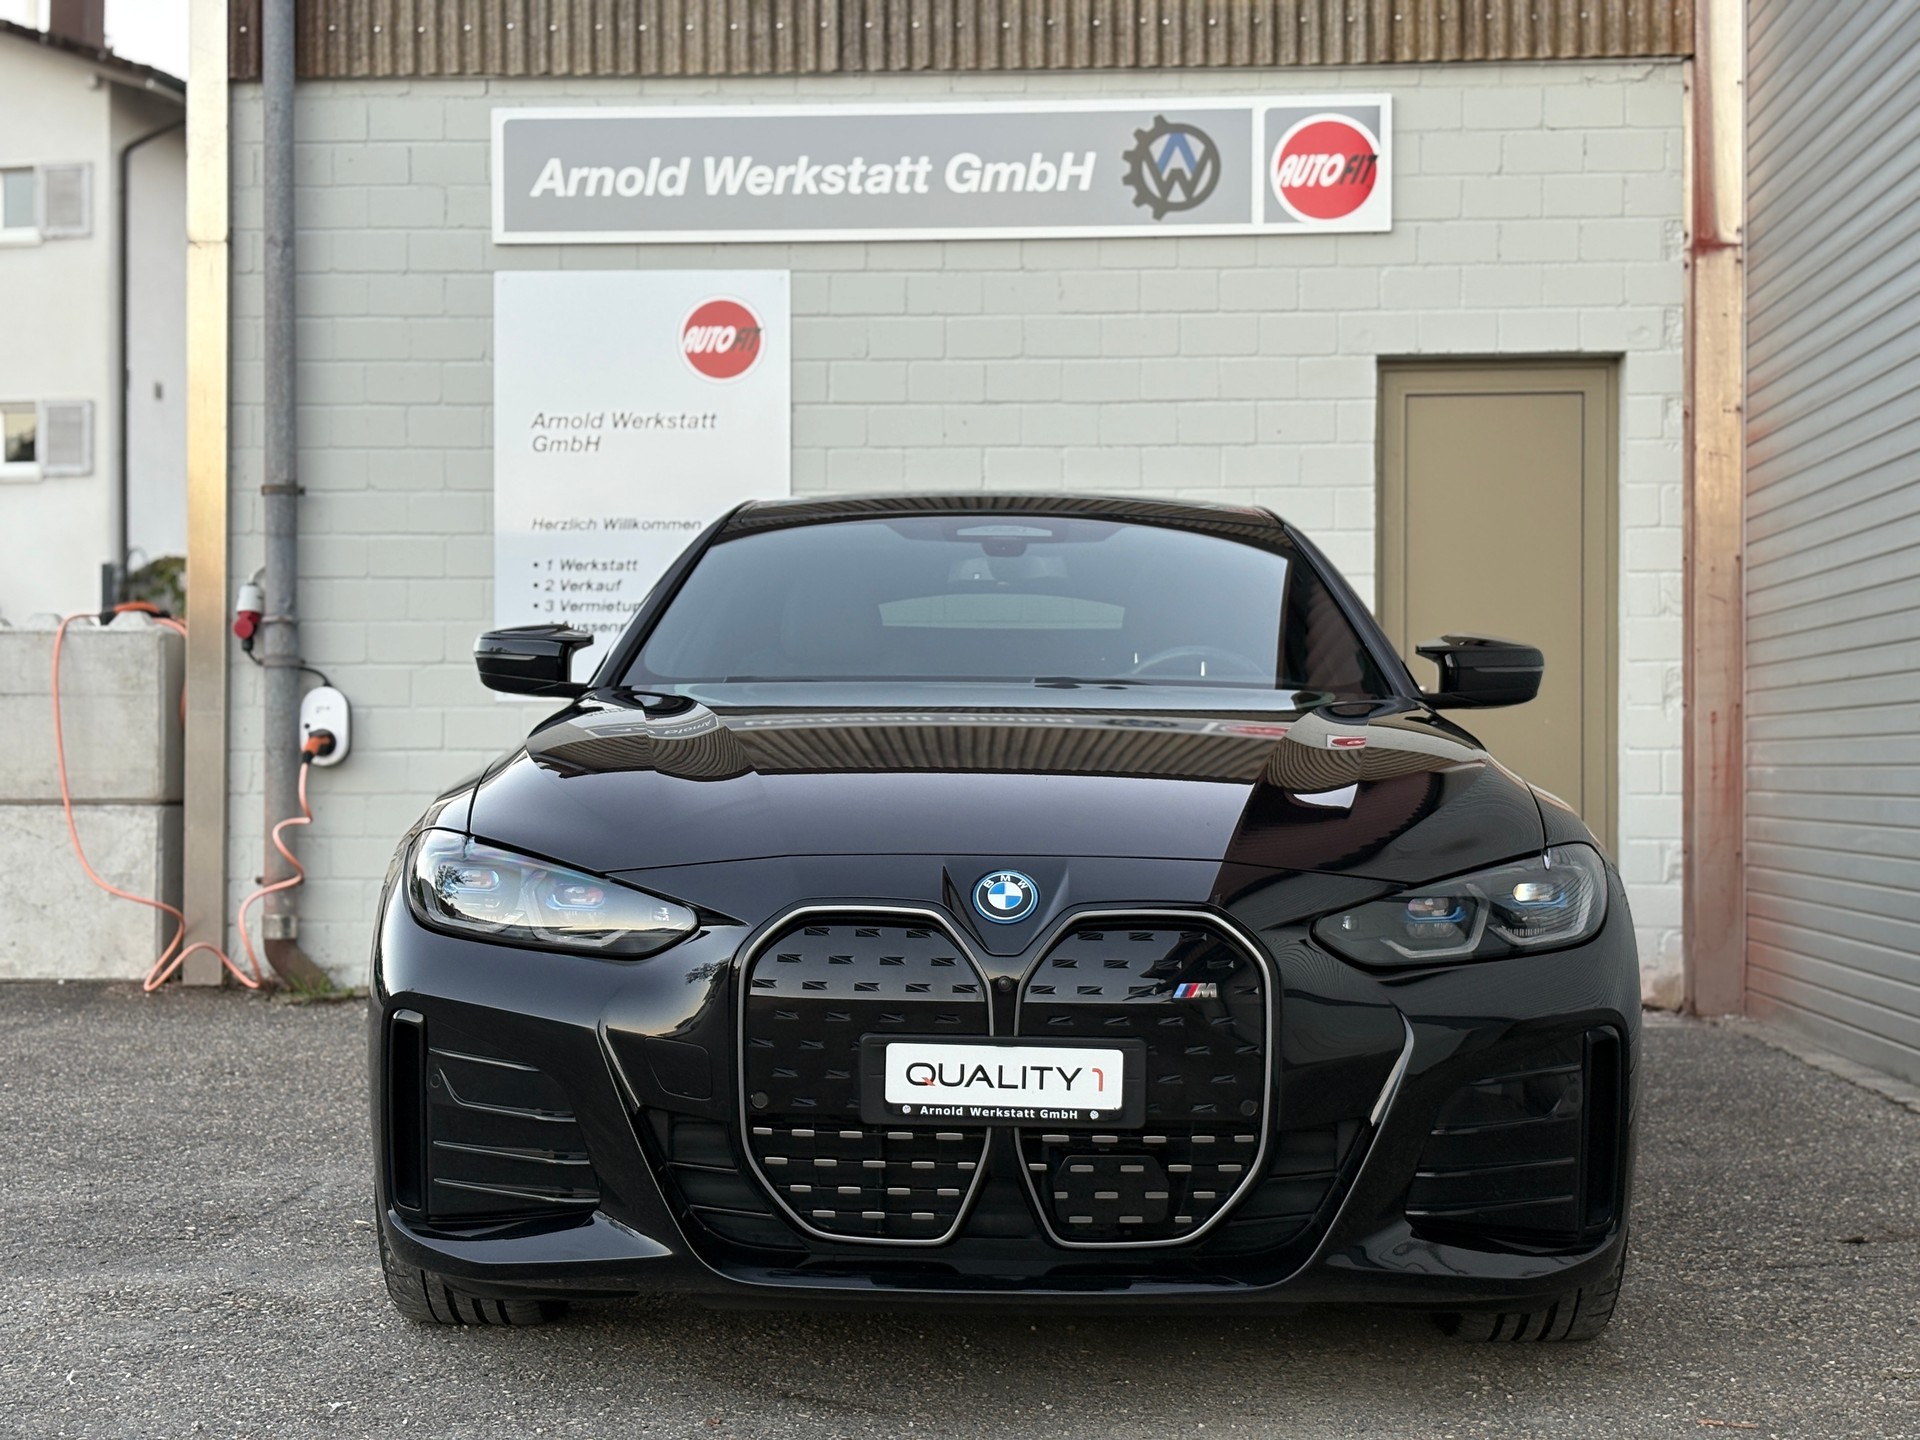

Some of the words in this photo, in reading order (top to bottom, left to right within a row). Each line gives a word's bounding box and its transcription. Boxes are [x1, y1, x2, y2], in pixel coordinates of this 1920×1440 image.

[529, 156, 691, 197] Arnold
[703, 155, 933, 196] Werkstatt
[944, 151, 1096, 194] GmbH
[1277, 152, 1379, 188] AUTOFIT
[683, 324, 762, 354] AUTOFIT
[531, 412, 605, 430] Arnold
[612, 412, 717, 430] Werkstatt
[532, 434, 601, 453] GmbH
[531, 518, 598, 531] Herzlich
[602, 518, 702, 531] Willkommen
[547, 559, 553, 572] 1
[560, 559, 639, 572] Werkstatt
[544, 579, 555, 592] 2
[560, 579, 623, 592] Verkauf
[544, 600, 554, 613] 3
[982, 874, 1029, 889] BMW
[920, 1105, 963, 1117] Arnold
[969, 1106, 1035, 1119] Werkstatt
[1040, 1108, 1078, 1120] GmbH
